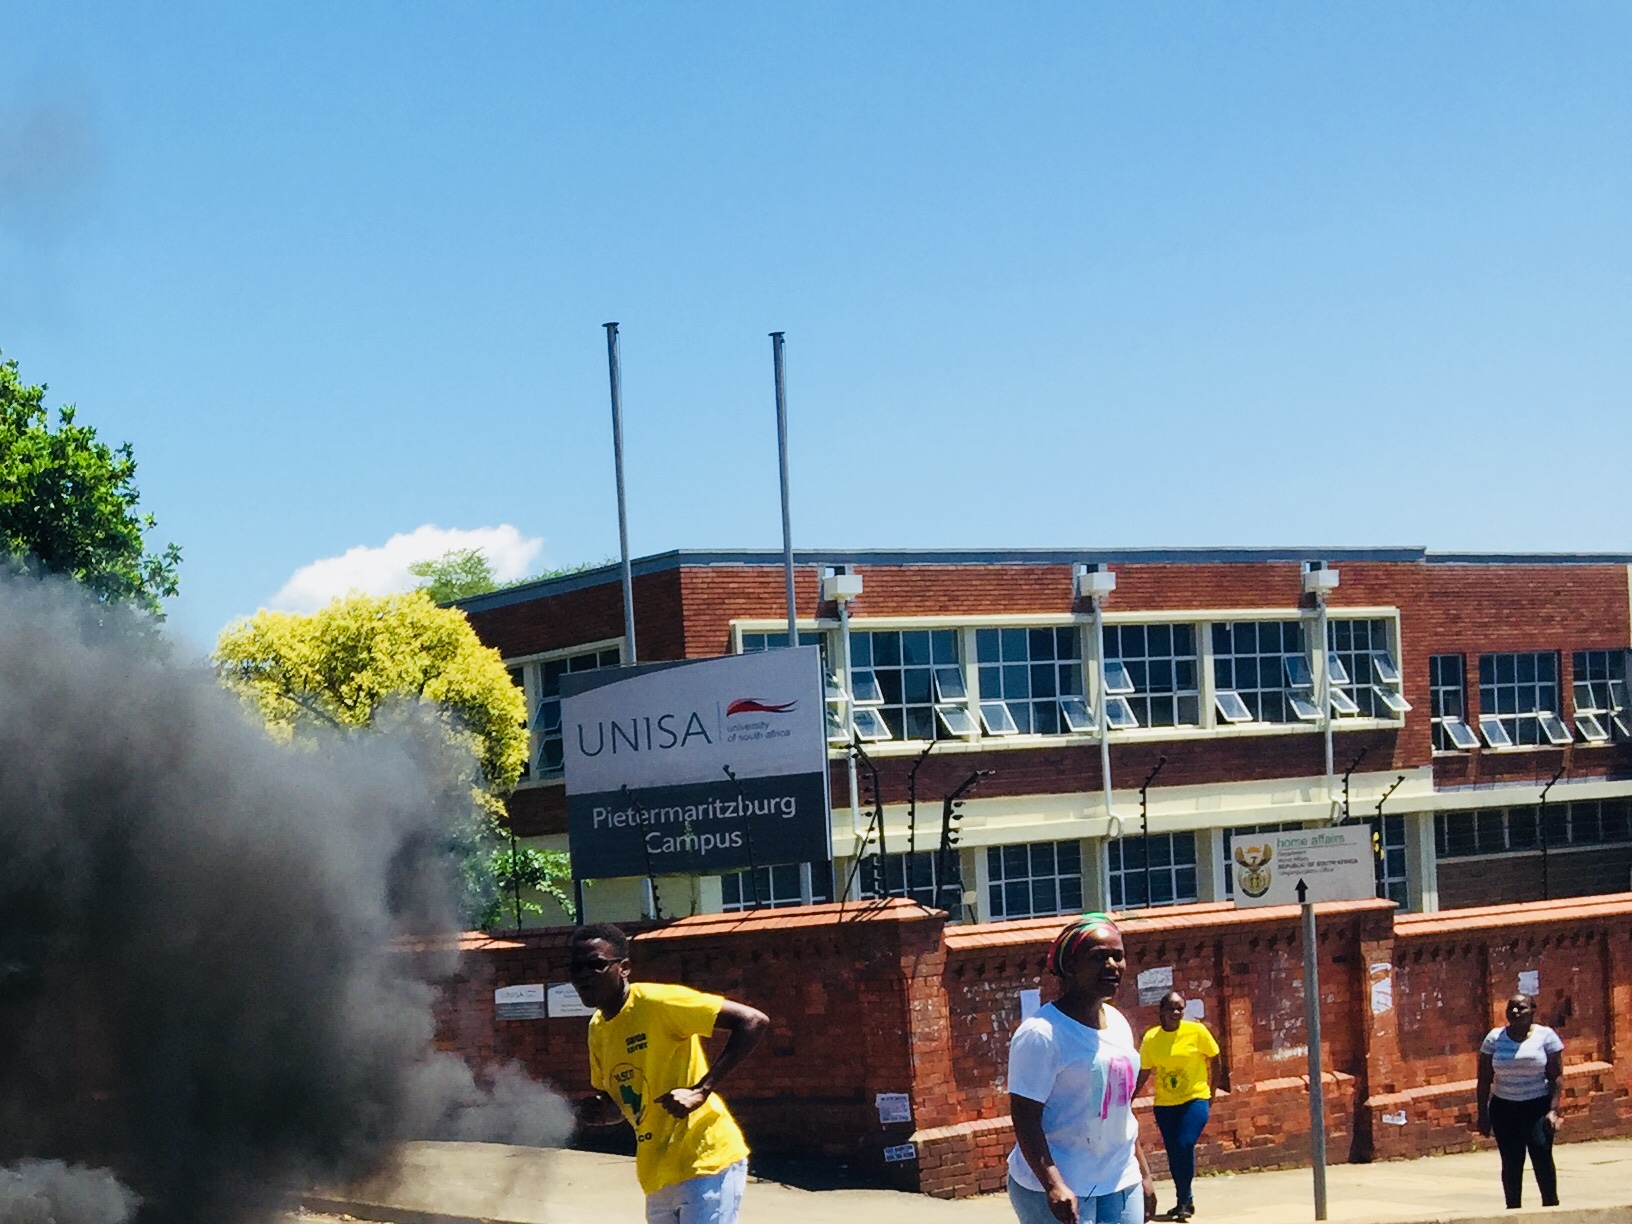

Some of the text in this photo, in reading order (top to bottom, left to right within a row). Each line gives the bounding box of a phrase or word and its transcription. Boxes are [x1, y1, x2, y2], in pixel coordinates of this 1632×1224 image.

[577, 711, 713, 757] UNISA
[726, 721, 770, 732] university
[726, 728, 791, 743] of south africa
[592, 795, 797, 829] Pietermaritzburg
[646, 829, 743, 855] Campus
[1277, 834, 1345, 848] home affairs
